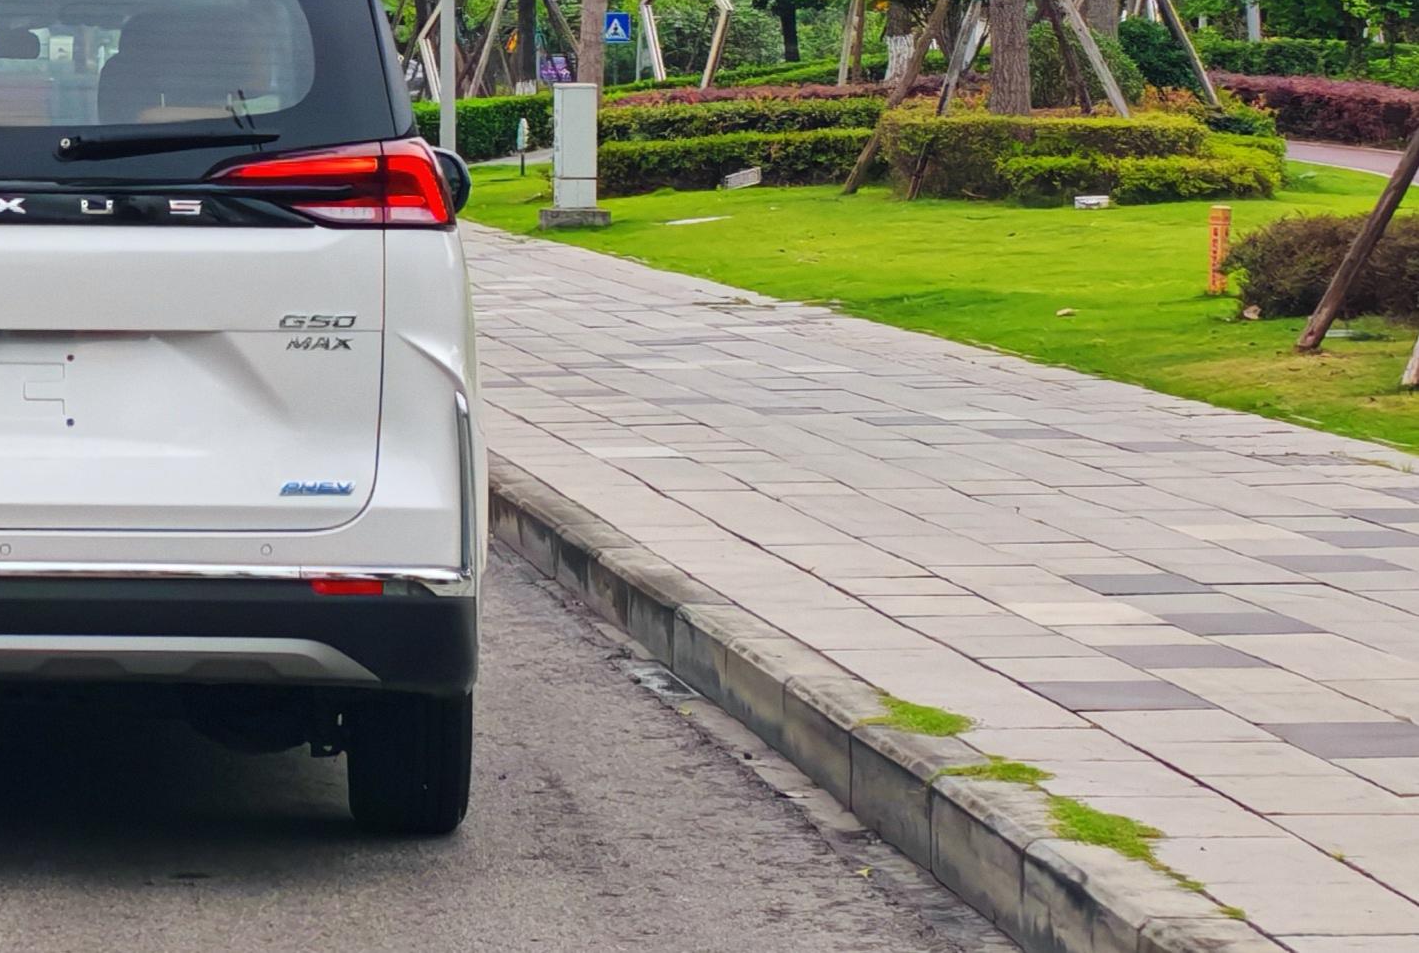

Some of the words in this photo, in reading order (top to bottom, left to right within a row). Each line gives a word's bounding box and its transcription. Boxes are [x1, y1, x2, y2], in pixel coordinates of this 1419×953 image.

[279, 315, 357, 329] G50
[286, 337, 354, 351] MAX
[279, 481, 355, 496] PHEV
